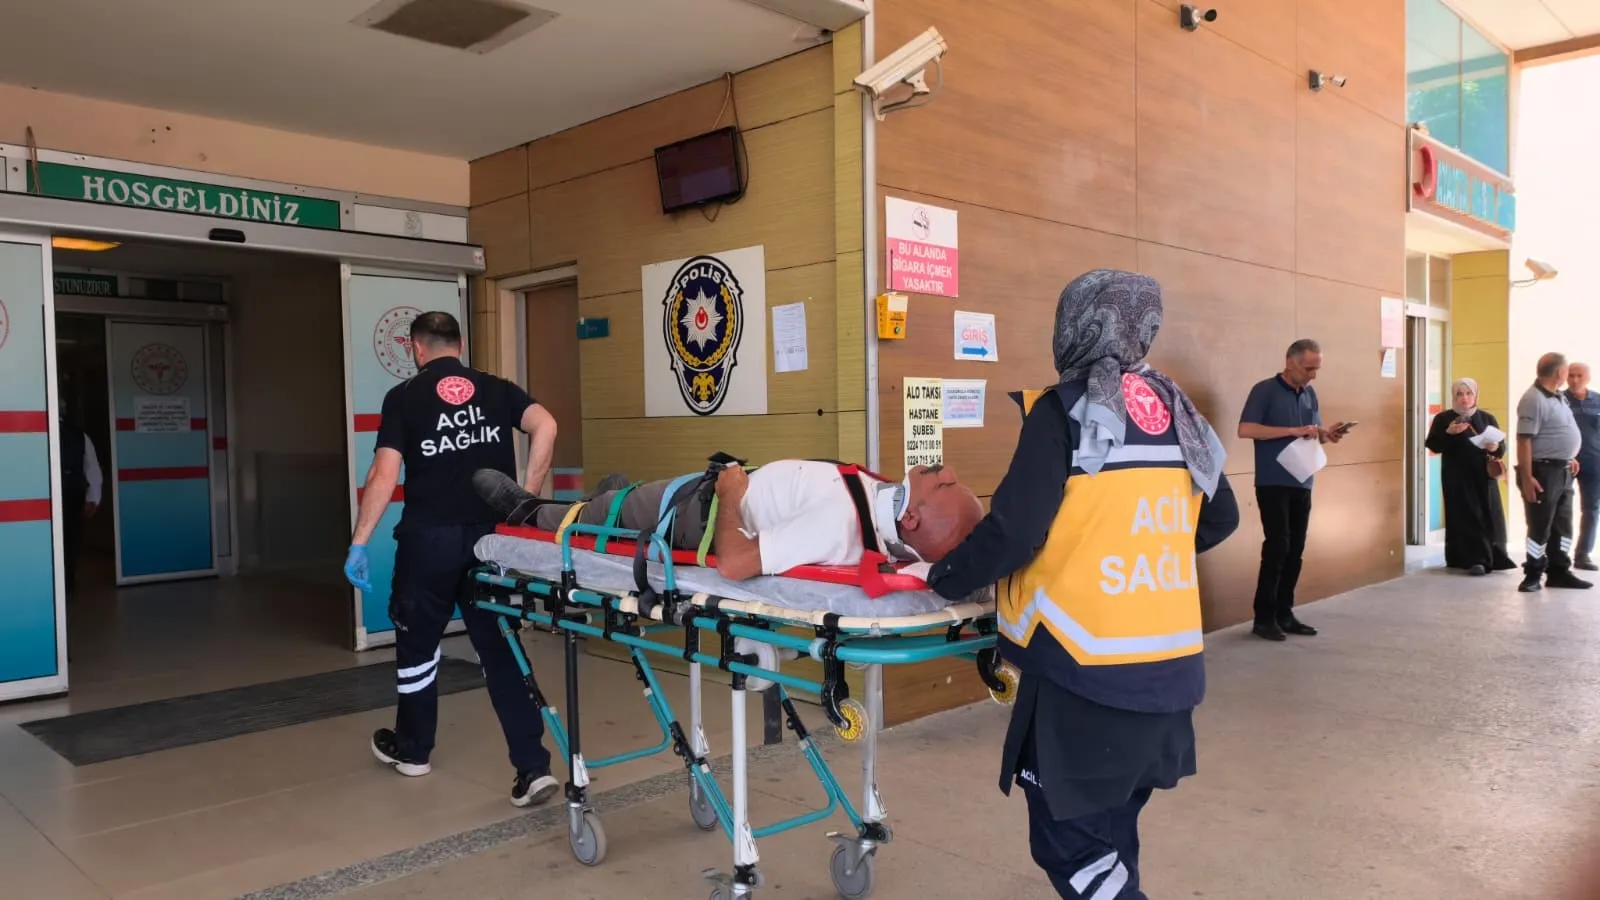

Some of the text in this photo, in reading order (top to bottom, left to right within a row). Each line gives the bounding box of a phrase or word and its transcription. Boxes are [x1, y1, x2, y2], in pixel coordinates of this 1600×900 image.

[82, 175, 299, 224] HOSGELDİNİZ
[898, 241, 947, 262] BU ALANDA
[680, 264, 721, 288] POLİS
[892, 257, 953, 279] SİGARA İÇMEK
[902, 277, 945, 294] YASAKTIR
[906, 386, 942, 400] ALO TAKSİ
[436, 404, 486, 431] ACİL
[909, 408, 938, 419] HASTANE
[420, 426, 501, 457] SAĞLIK
[912, 425, 935, 438] ŞUBESİ
[1130, 487, 1192, 535] ACİL
